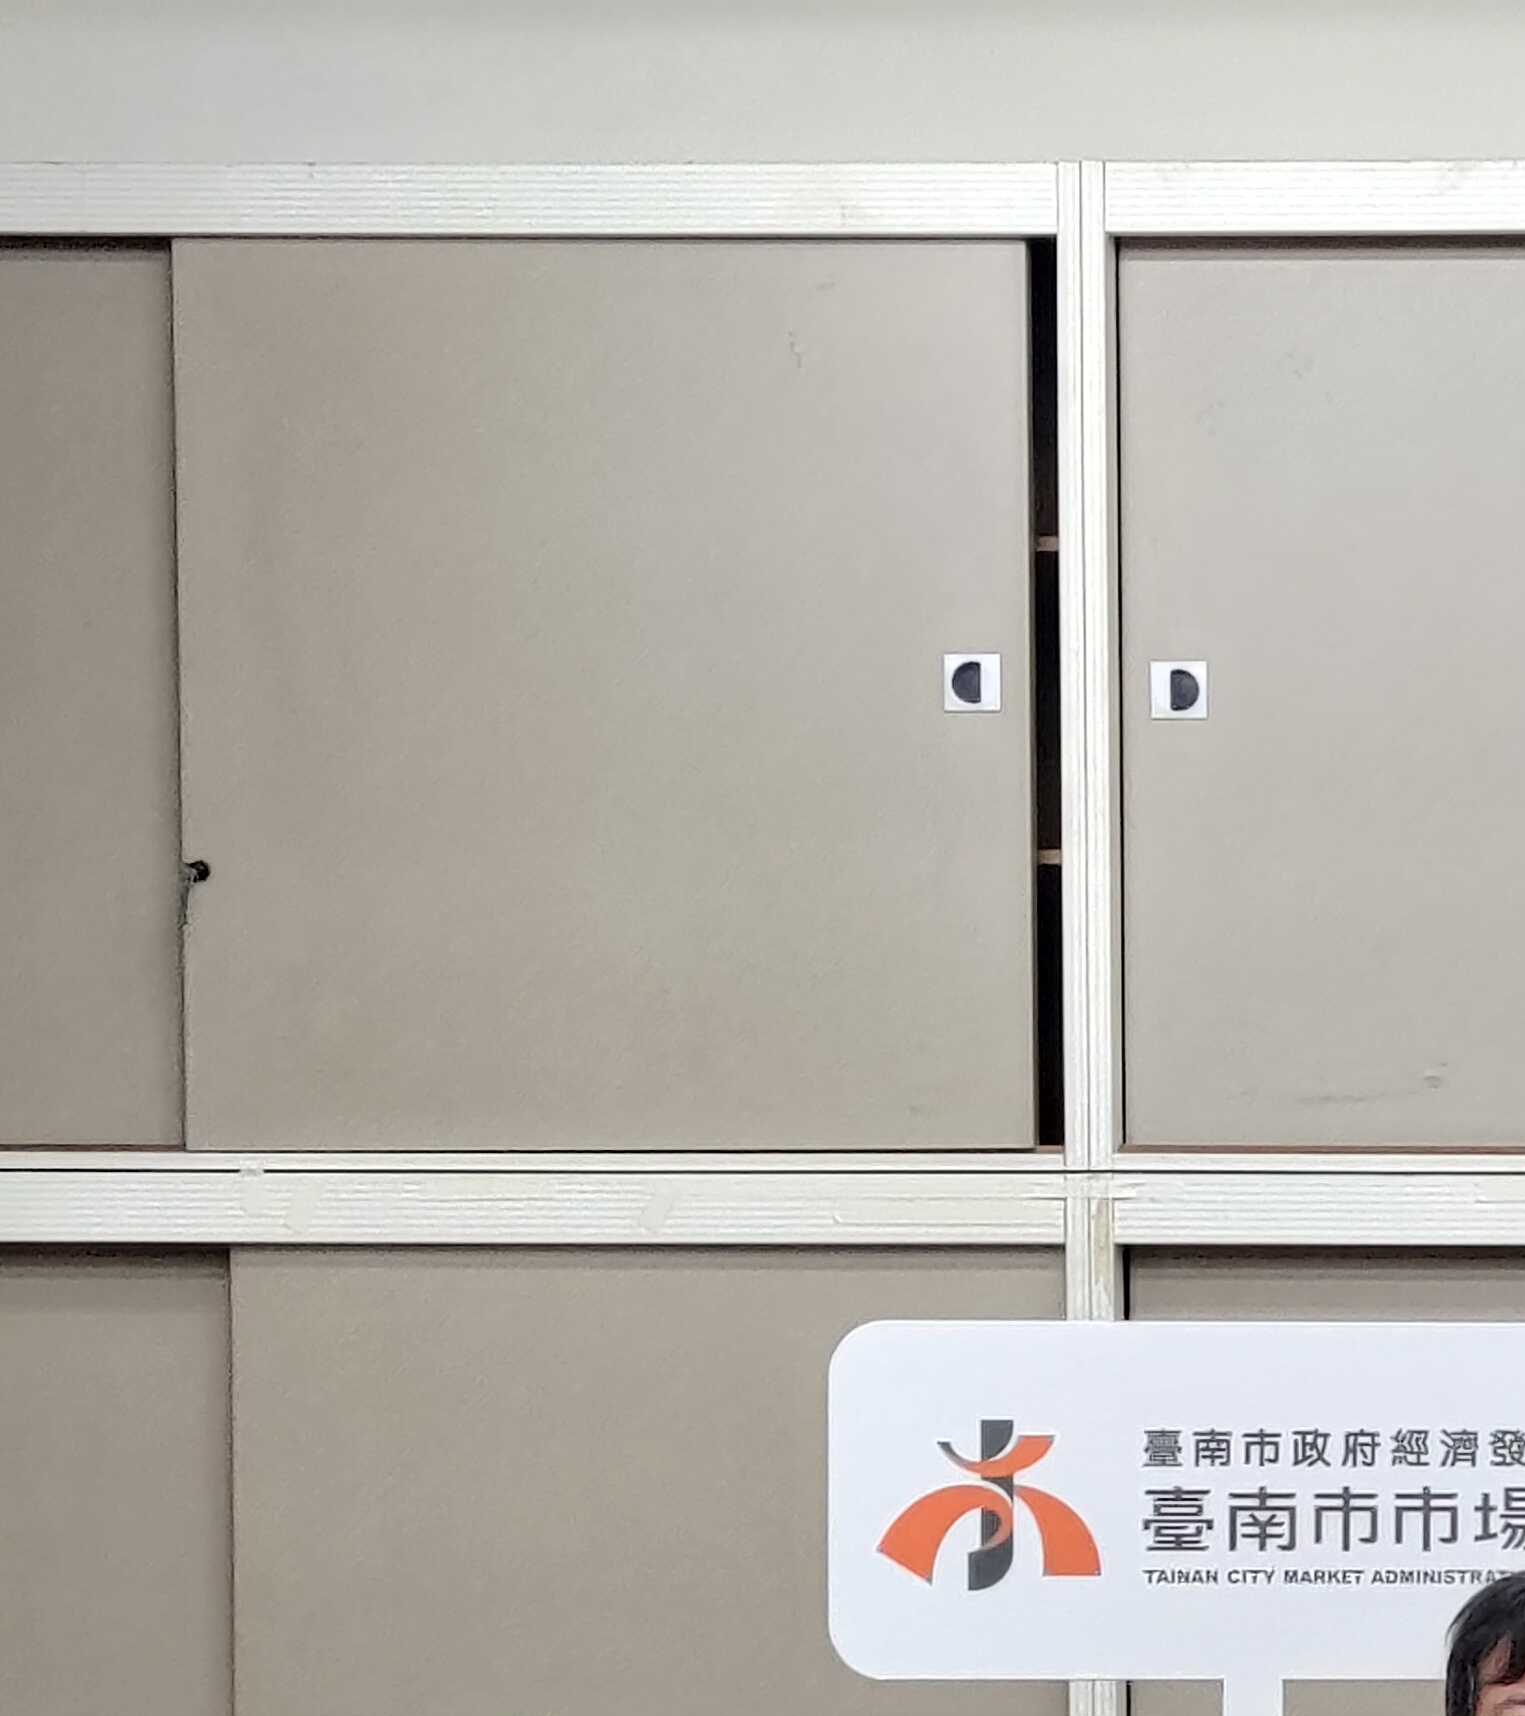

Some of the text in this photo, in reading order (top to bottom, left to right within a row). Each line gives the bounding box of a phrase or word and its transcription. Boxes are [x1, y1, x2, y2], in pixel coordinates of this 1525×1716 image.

[1143, 1569, 1218, 1586] TAINAN
[1227, 1569, 1275, 1586] CITY
[1284, 1569, 1364, 1586] MARKET
